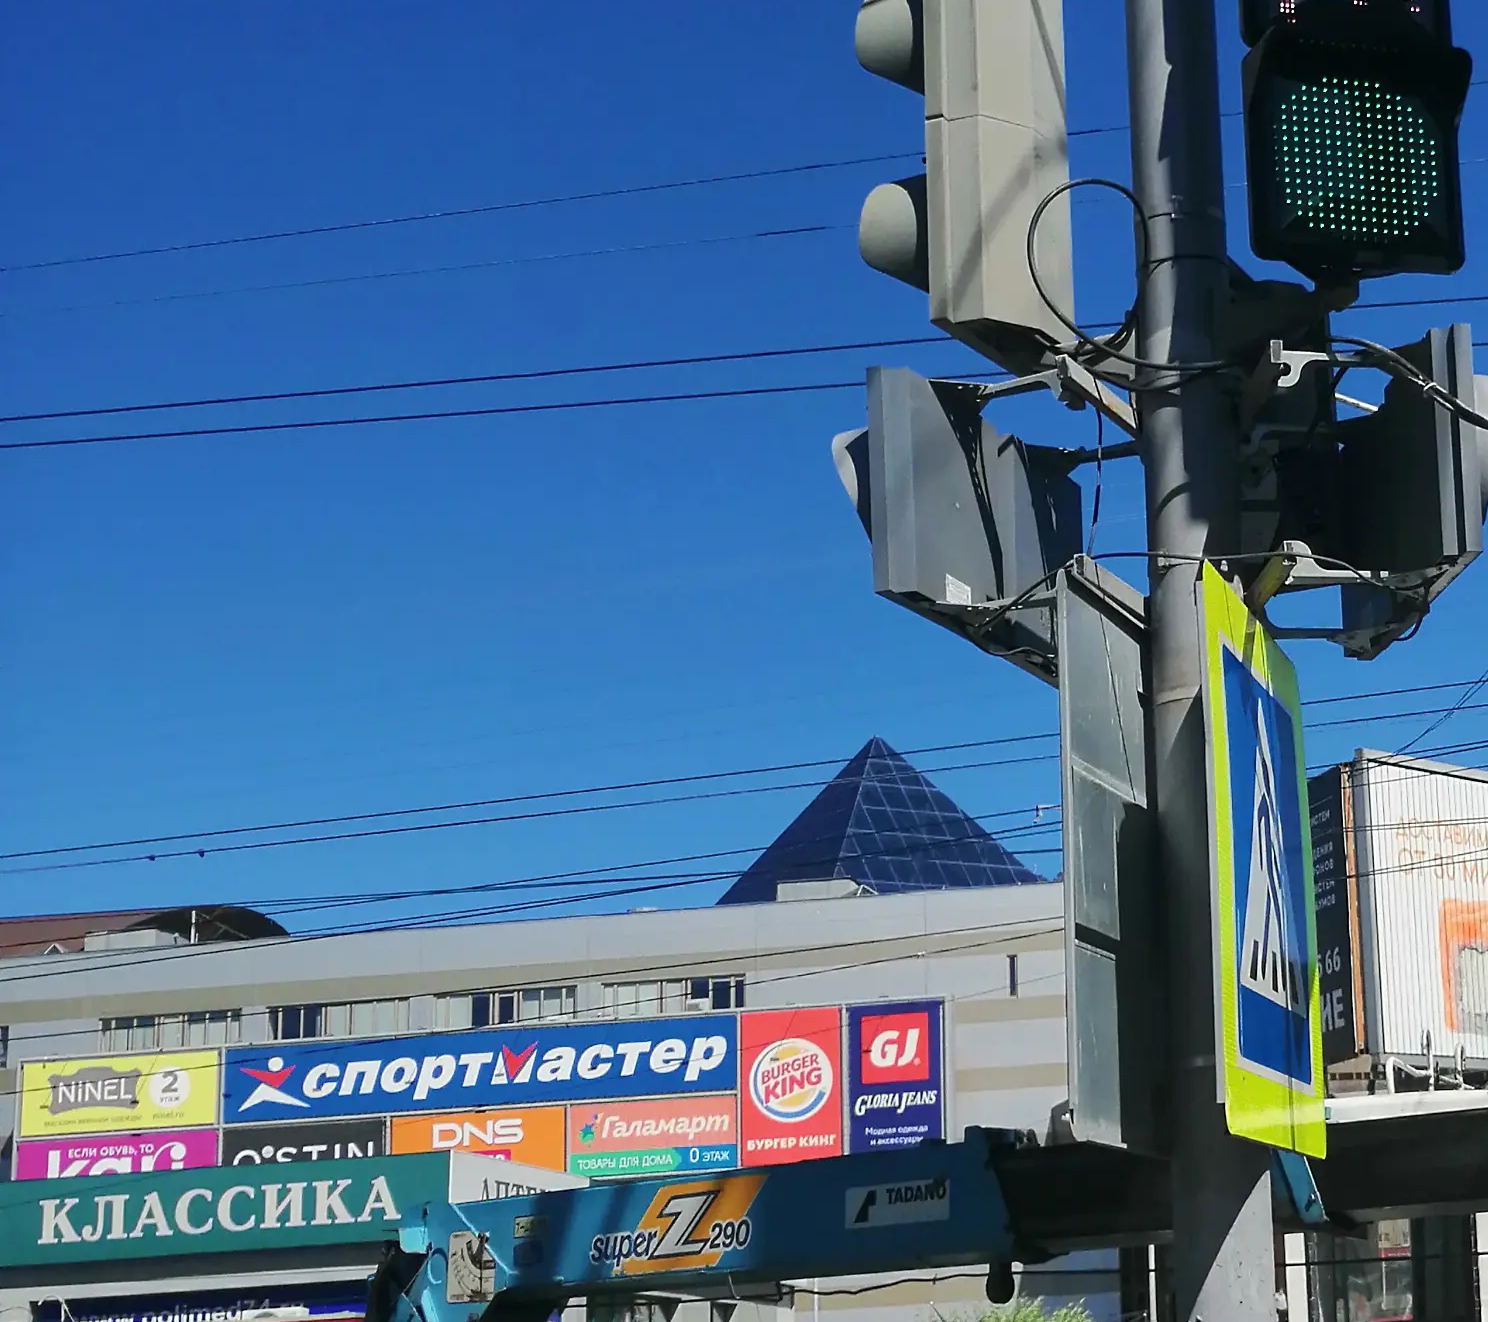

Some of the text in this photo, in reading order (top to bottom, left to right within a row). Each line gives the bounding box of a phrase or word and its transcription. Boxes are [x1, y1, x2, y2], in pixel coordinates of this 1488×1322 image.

[760, 1054, 819, 1085] BURGER
[161, 1071, 178, 1093] 2
[763, 1067, 822, 1105] KING
[855, 1090, 938, 1116] GLORIA JEANS
[432, 1118, 524, 1149] DNS
[601, 1114, 730, 1140] Галамарт
[865, 1124, 928, 1135] Модная одежда
[68, 1146, 97, 1158] ЕСЛИ
[140, 1143, 155, 1154] ТО
[747, 1134, 837, 1151] БУРГЕР КИНГ
[577, 1154, 673, 1170] ТОВАРЫ ДЛЯ ДОМА
[702, 1151, 730, 1162] ЭТАЖ
[886, 1183, 947, 1205] TADANO
[37, 1175, 401, 1245] КЛАССИКА
